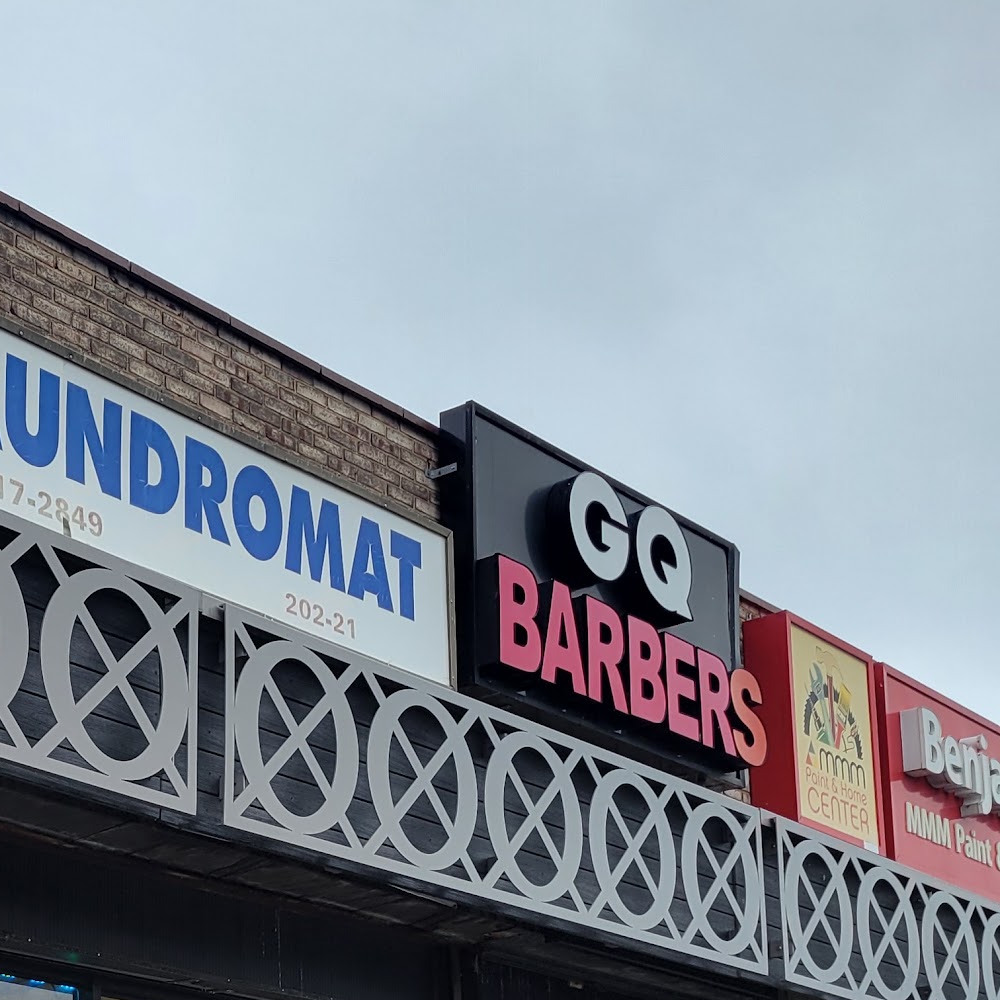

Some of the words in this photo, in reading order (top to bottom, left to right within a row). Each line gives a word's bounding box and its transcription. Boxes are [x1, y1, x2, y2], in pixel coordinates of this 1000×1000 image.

[569, 471, 694, 622] GQ
[284, 593, 357, 640] 202-21
[498, 554, 768, 767] BARBERS
[805, 766, 829, 793] Paint
[840, 780, 868, 807] Home
[807, 786, 870, 835] CENTER
[905, 801, 952, 849] MMM
[954, 823, 993, 867] Paint
